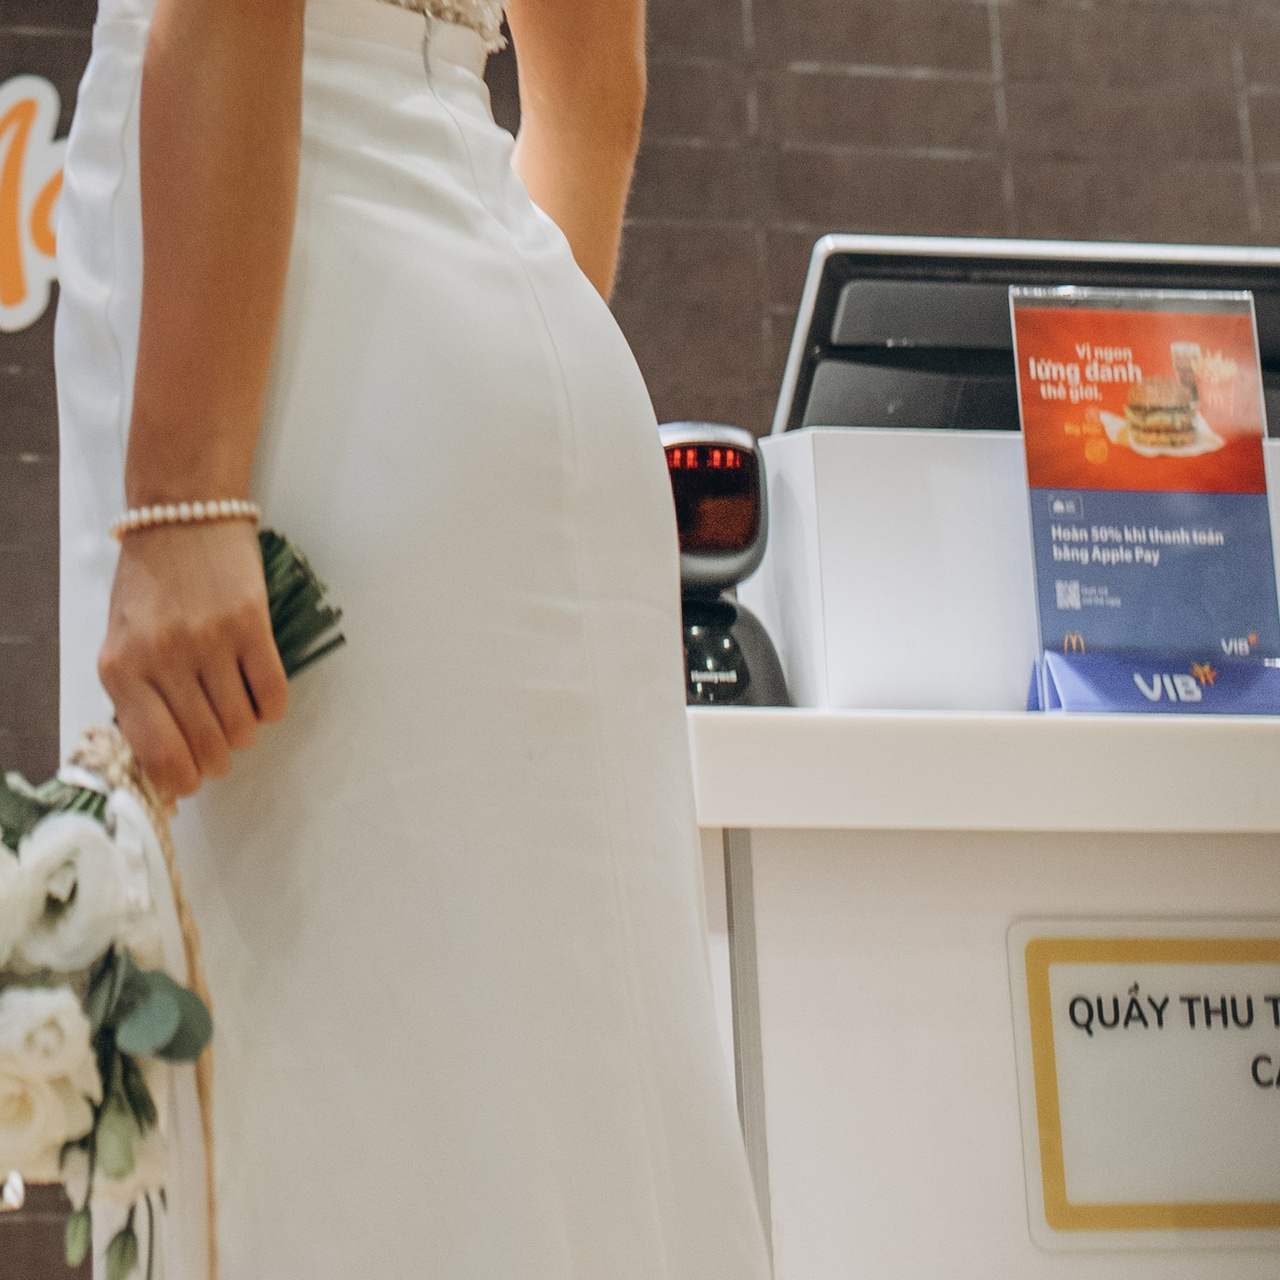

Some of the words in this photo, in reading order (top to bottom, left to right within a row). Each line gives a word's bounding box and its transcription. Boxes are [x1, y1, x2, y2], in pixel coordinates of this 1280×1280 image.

[1085, 357, 1142, 384] danh
[1091, 525, 1121, 542] 50%
[1124, 525, 1147, 544] khi
[1149, 527, 1190, 545] thanh
[1092, 545, 1132, 565] Apple
[1135, 546, 1160, 567] Pay
[1221, 638, 1250, 656] VIB
[1133, 673, 1202, 702] VIB
[1179, 993, 1254, 1029] THU
